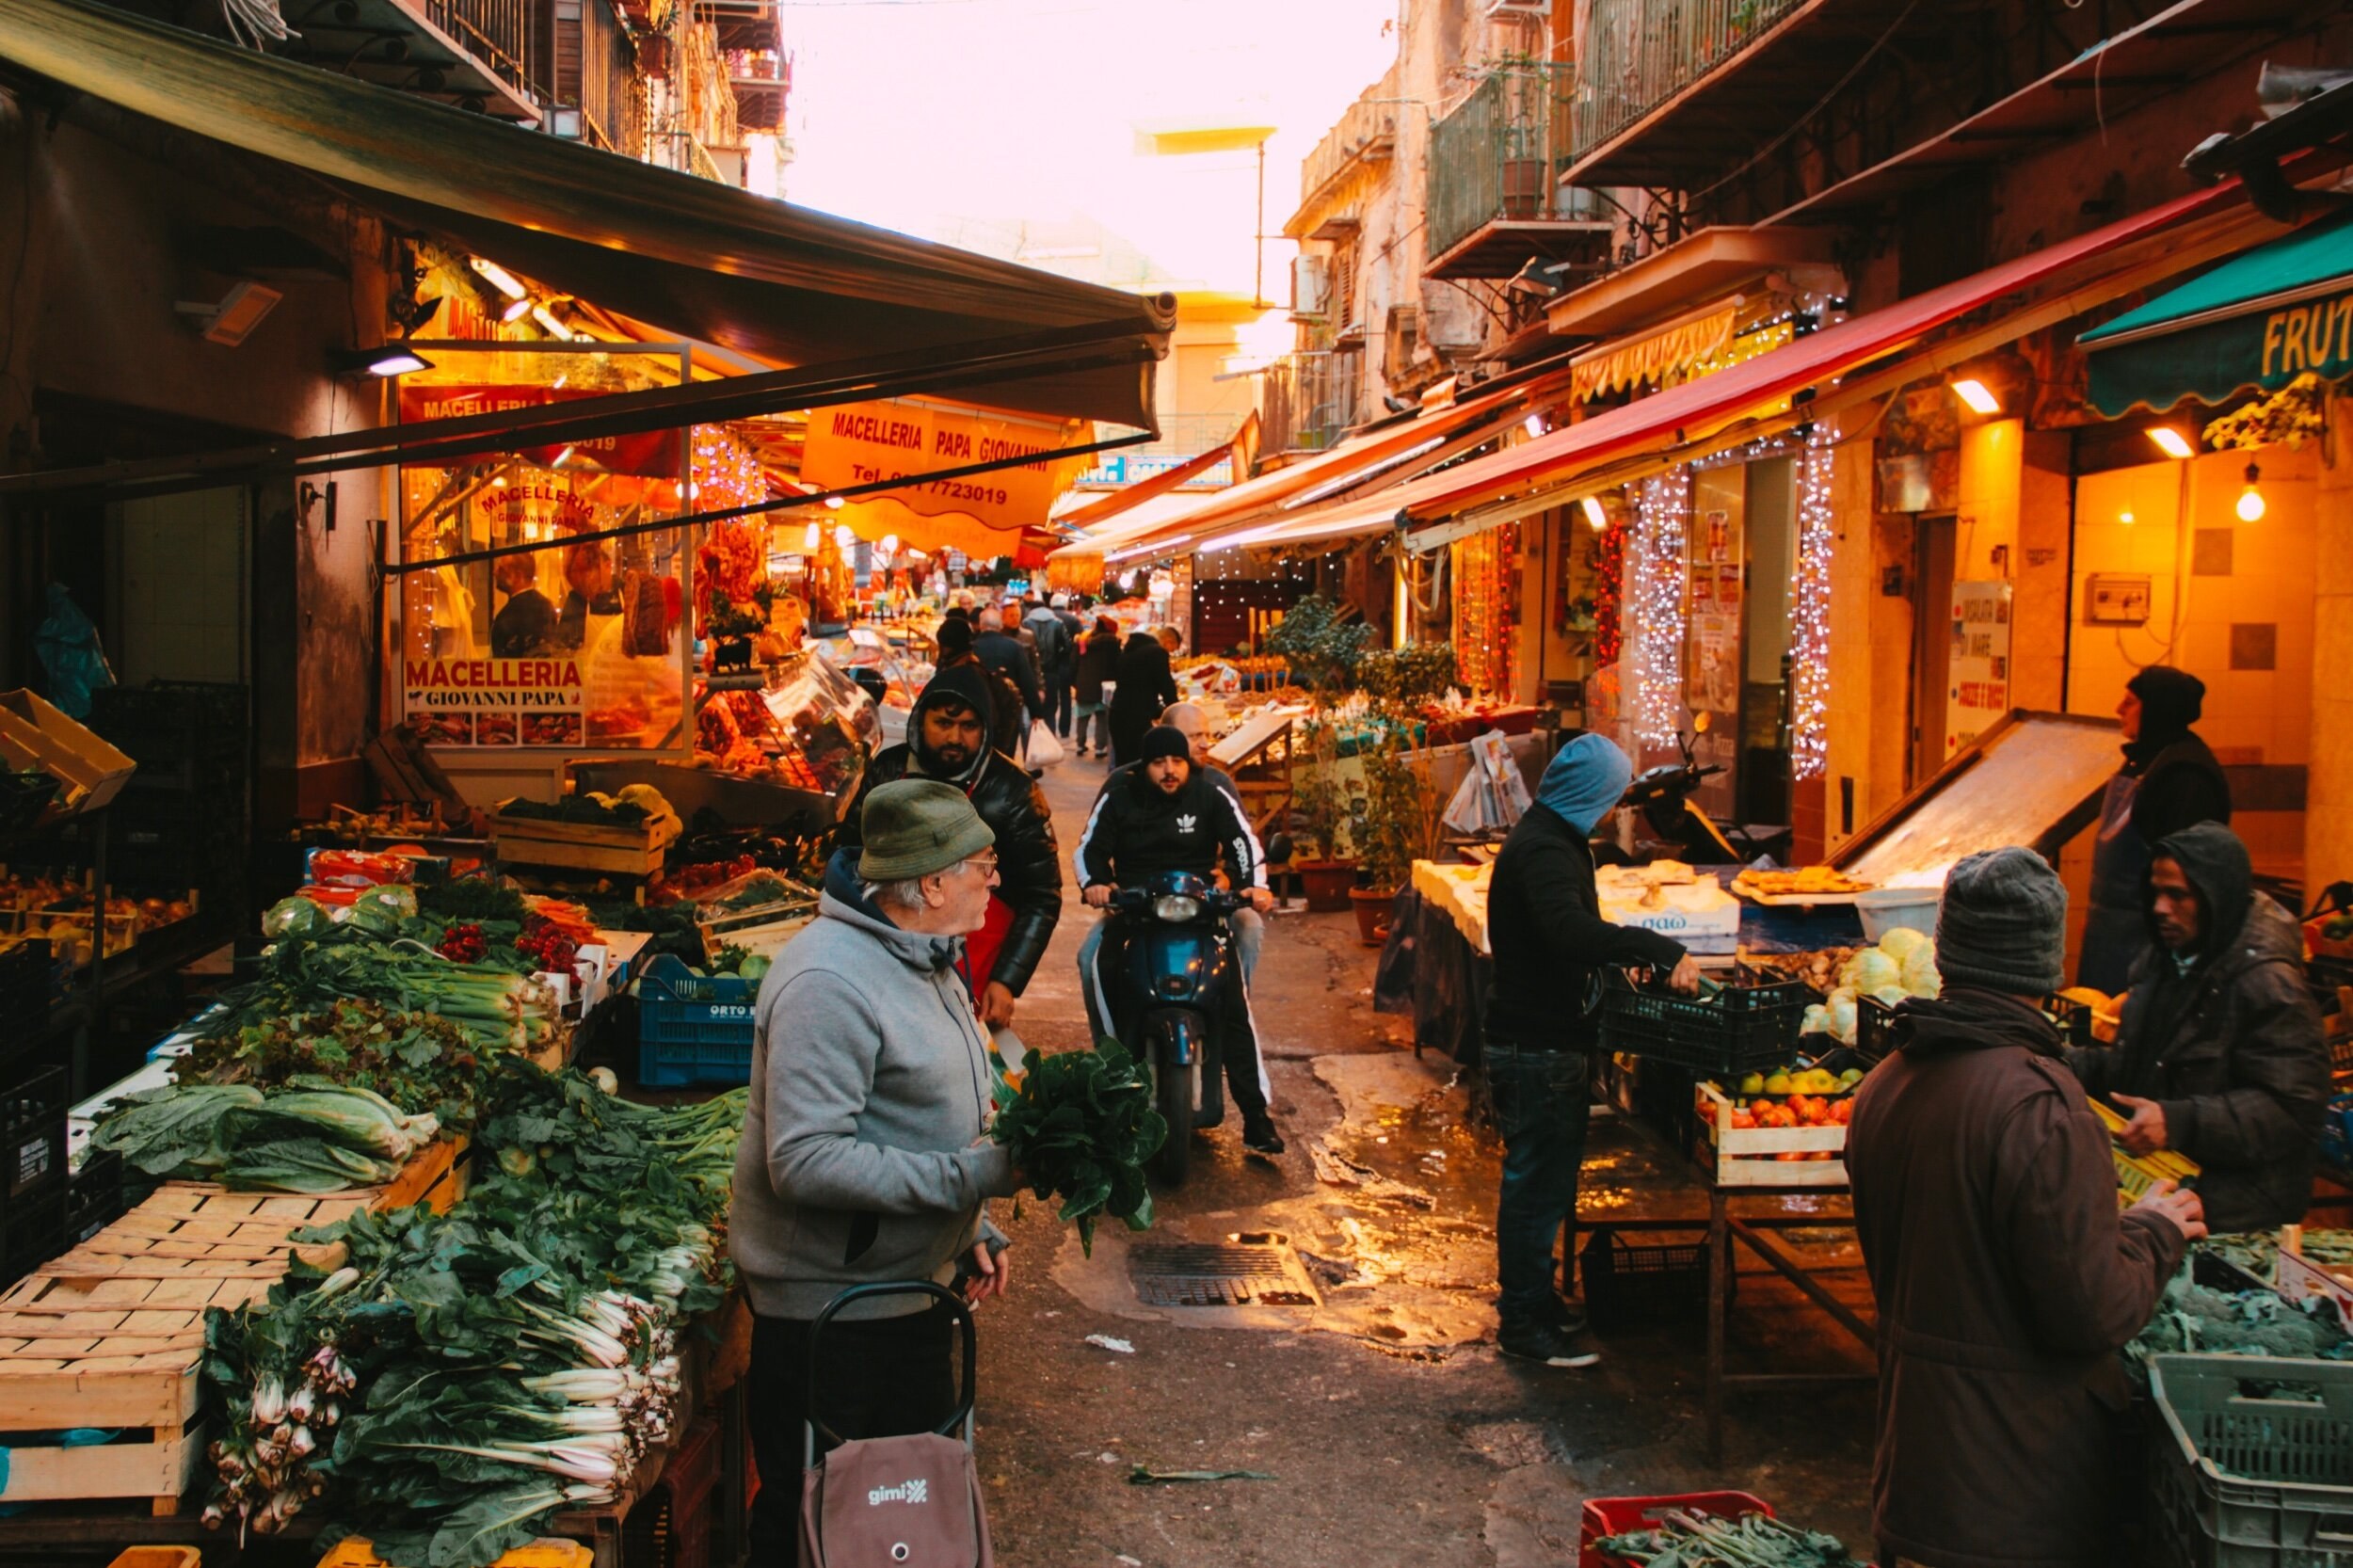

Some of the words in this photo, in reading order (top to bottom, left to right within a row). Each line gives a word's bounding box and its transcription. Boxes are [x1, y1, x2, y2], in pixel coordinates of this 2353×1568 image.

[832, 412, 921, 451] MACELLERIA
[936, 431, 970, 459] PAPA
[852, 464, 885, 484] Tel.
[930, 480, 1007, 504] 7723019
[481, 486, 595, 519] MACELLERIA
[498, 513, 549, 525] GIOVANNI
[406, 661, 582, 688] MACELLERIA
[425, 691, 517, 706] GIOVANNI
[522, 691, 567, 706] PAPA
[710, 1005, 745, 1016] ORTO
[868, 1483, 906, 1506] gimi
